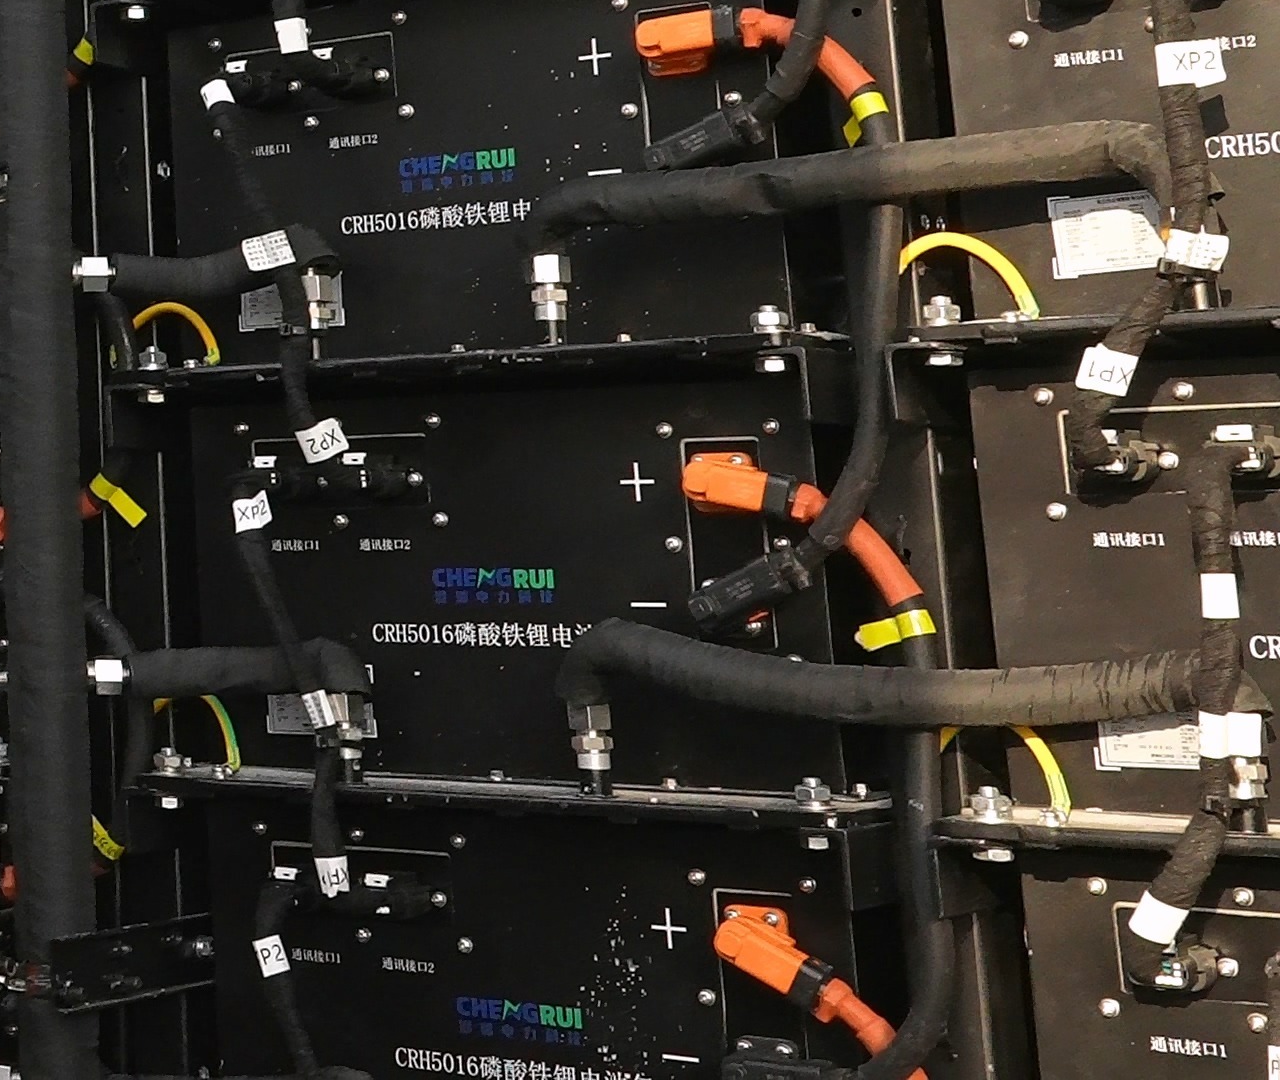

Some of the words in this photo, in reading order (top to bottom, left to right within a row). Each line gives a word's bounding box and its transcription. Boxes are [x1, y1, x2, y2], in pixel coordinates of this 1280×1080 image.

[1054, 50, 1124, 68] 通讯接口1
[1173, 50, 1217, 73] XP2
[329, 133, 379, 150] 通讯接口2
[399, 148, 516, 178] CHENGRUI
[1088, 358, 1130, 386] XP1
[306, 429, 342, 455] XP2
[237, 498, 269, 522] XP2
[271, 538, 320, 552] 通讯接口1
[359, 538, 412, 552] 通讯接口2
[1093, 531, 1165, 548] 通讯接口1
[432, 567, 555, 589] CHENGRUI
[291, 947, 341, 964] 通讯接口1
[382, 956, 436, 974] 通讯接口2
[456, 996, 584, 1030] CHENGRUI
[1151, 1036, 1227, 1059] 通讯接口1
